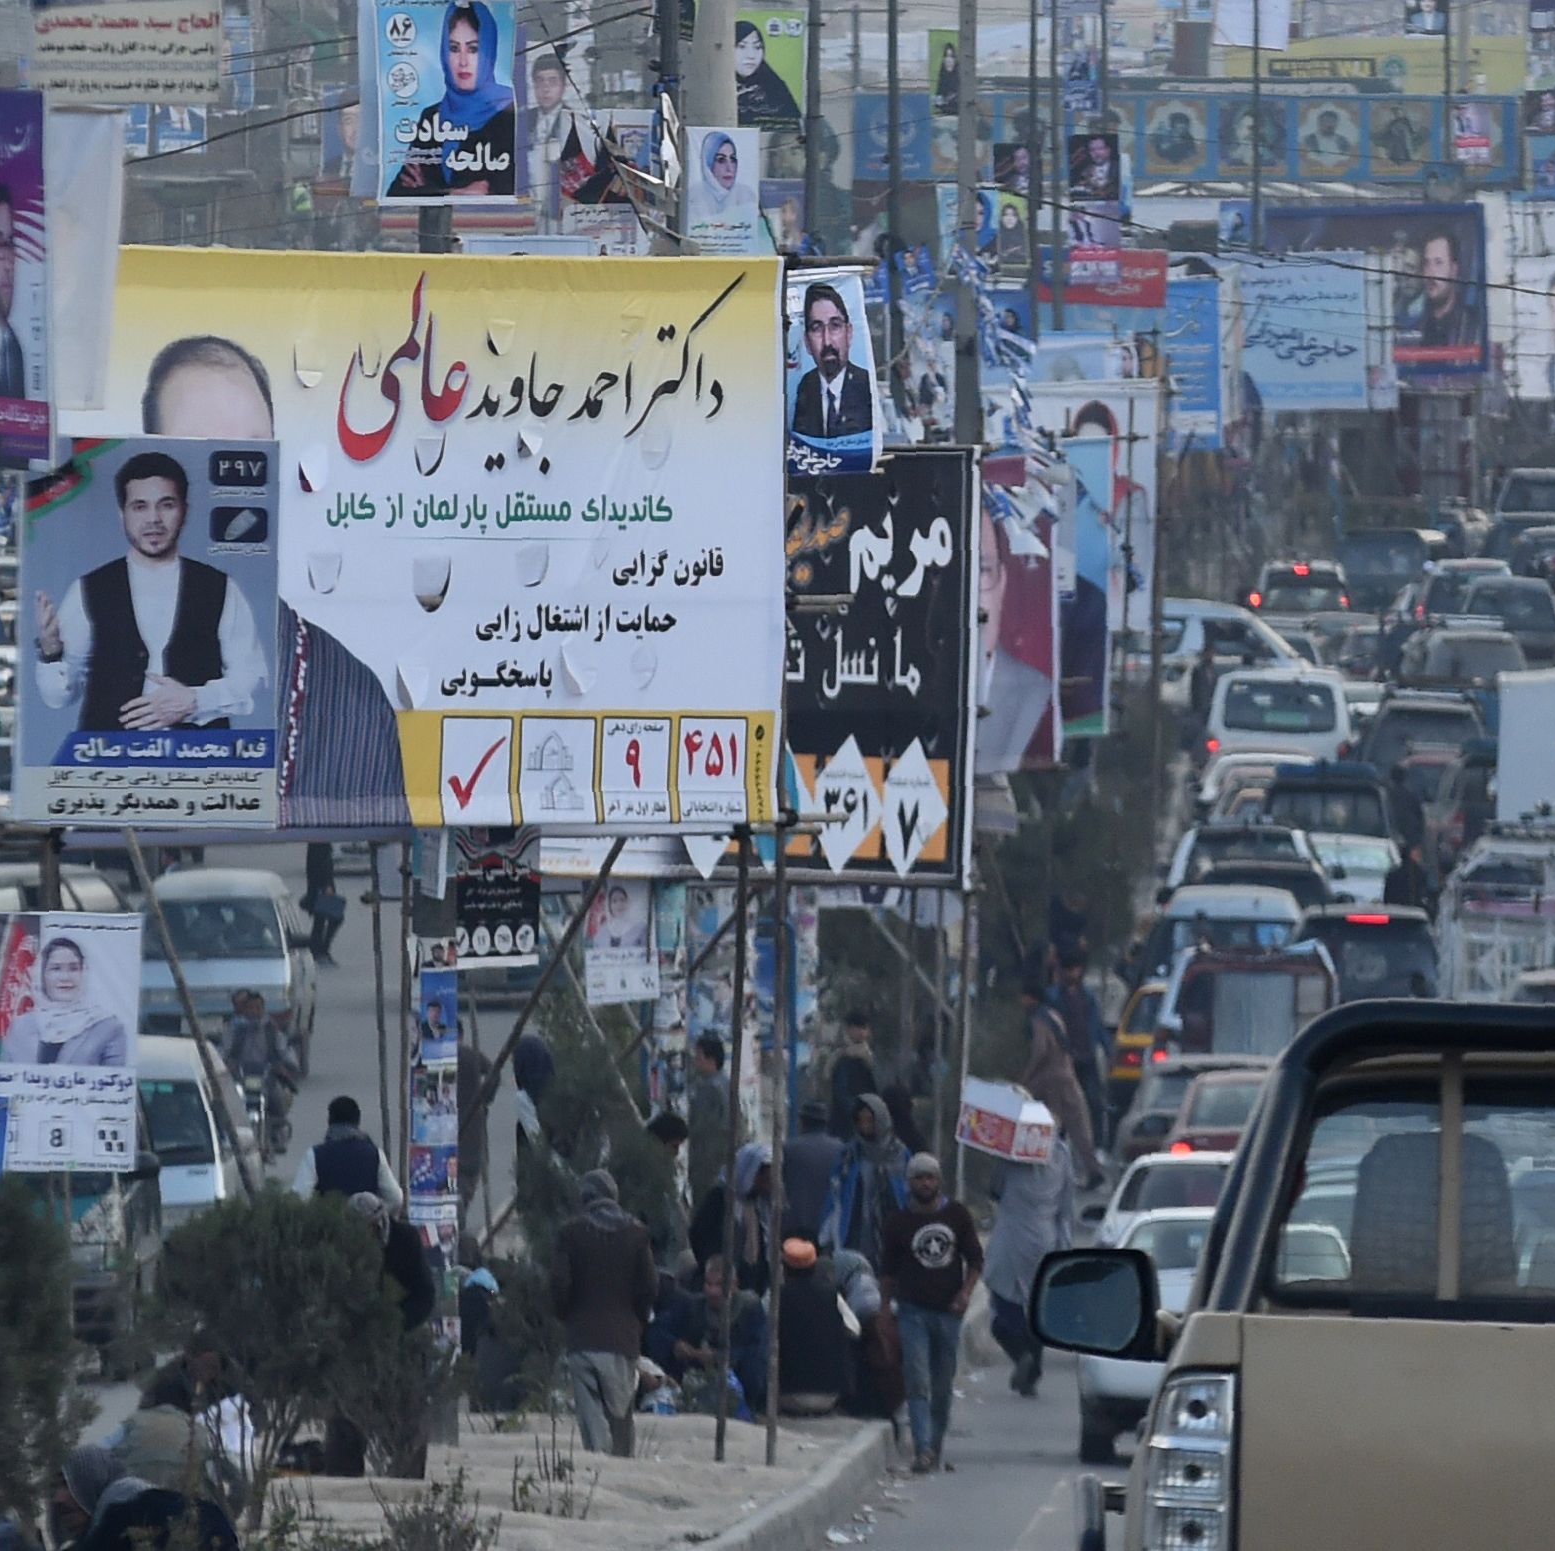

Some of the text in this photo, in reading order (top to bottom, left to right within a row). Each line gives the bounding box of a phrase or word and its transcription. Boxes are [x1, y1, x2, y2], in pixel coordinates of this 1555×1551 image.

[144, 14, 173, 31] سید
[177, 11, 220, 34] الحاج
[389, 17, 413, 37] ۸۶
[396, 111, 469, 143] سعادت
[445, 142, 511, 173] صالحه
[336, 269, 747, 475] داکتر احمد جاوید عالمی
[218, 459, 263, 478] ۲۹۷
[325, 490, 674, 535] کاندیدای مستقل پارلمان از کابل
[611, 547, 725, 587] قانون گرایی
[848, 510, 954, 598] مریم
[474, 603, 679, 643] حمایت از اشتغال زایی
[822, 625, 921, 699] ما نسل
[439, 659, 555, 699] پاسخگویی
[72, 736, 267, 763] فدا محمد الفت صالح
[624, 738, 642, 789] ۹
[683, 728, 739, 778] ۴۵۱
[47, 791, 261, 817] عدالت و همدیگر پذیری
[823, 786, 869, 832] ۳۶۱
[898, 799, 920, 862] ۷
[22, 1070, 50, 1089] ویدا
[52, 1071, 87, 1090] ماری
[88, 1073, 134, 1093] دوکتور
[49, 1127, 65, 1148] 8
